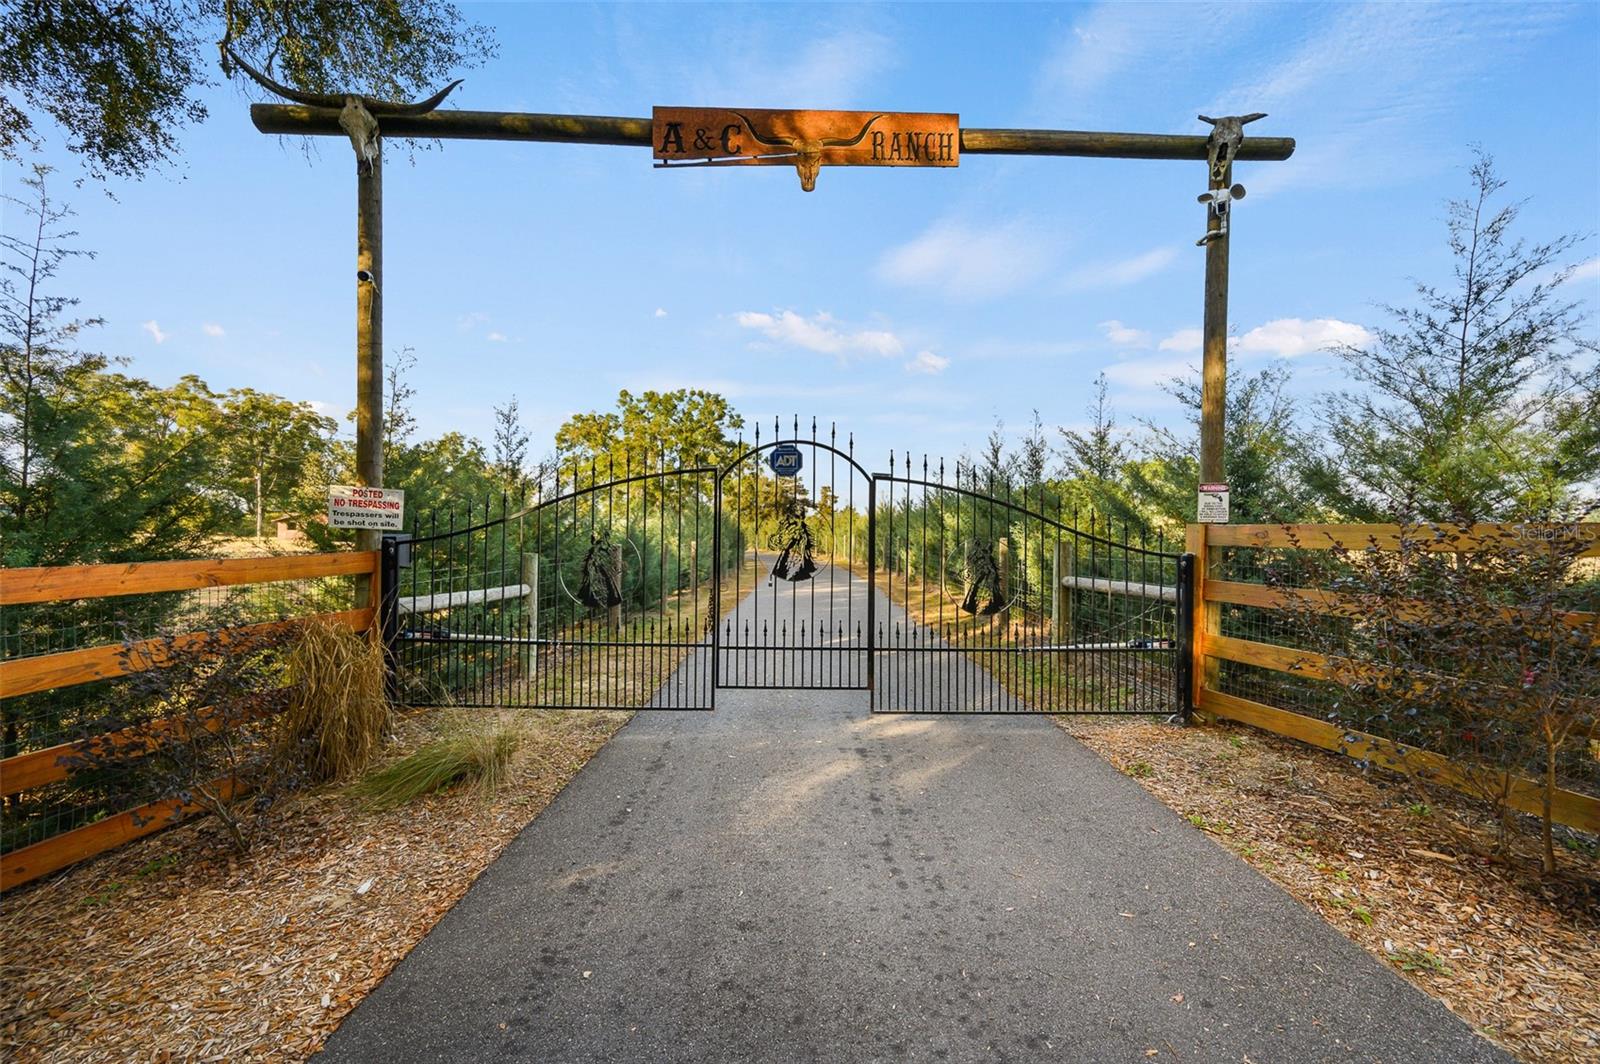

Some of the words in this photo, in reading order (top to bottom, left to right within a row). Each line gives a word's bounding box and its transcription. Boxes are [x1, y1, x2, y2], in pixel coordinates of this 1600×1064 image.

[658, 122, 687, 153] A
[693, 128, 715, 151] &
[719, 124, 742, 155] C
[870, 130, 955, 162] RANCH
[776, 455, 797, 467] ADT
[352, 489, 384, 499] POSTED
[334, 498, 346, 508] NO
[348, 499, 400, 510] TRESPASSING
[332, 510, 383, 519] Trespassers
